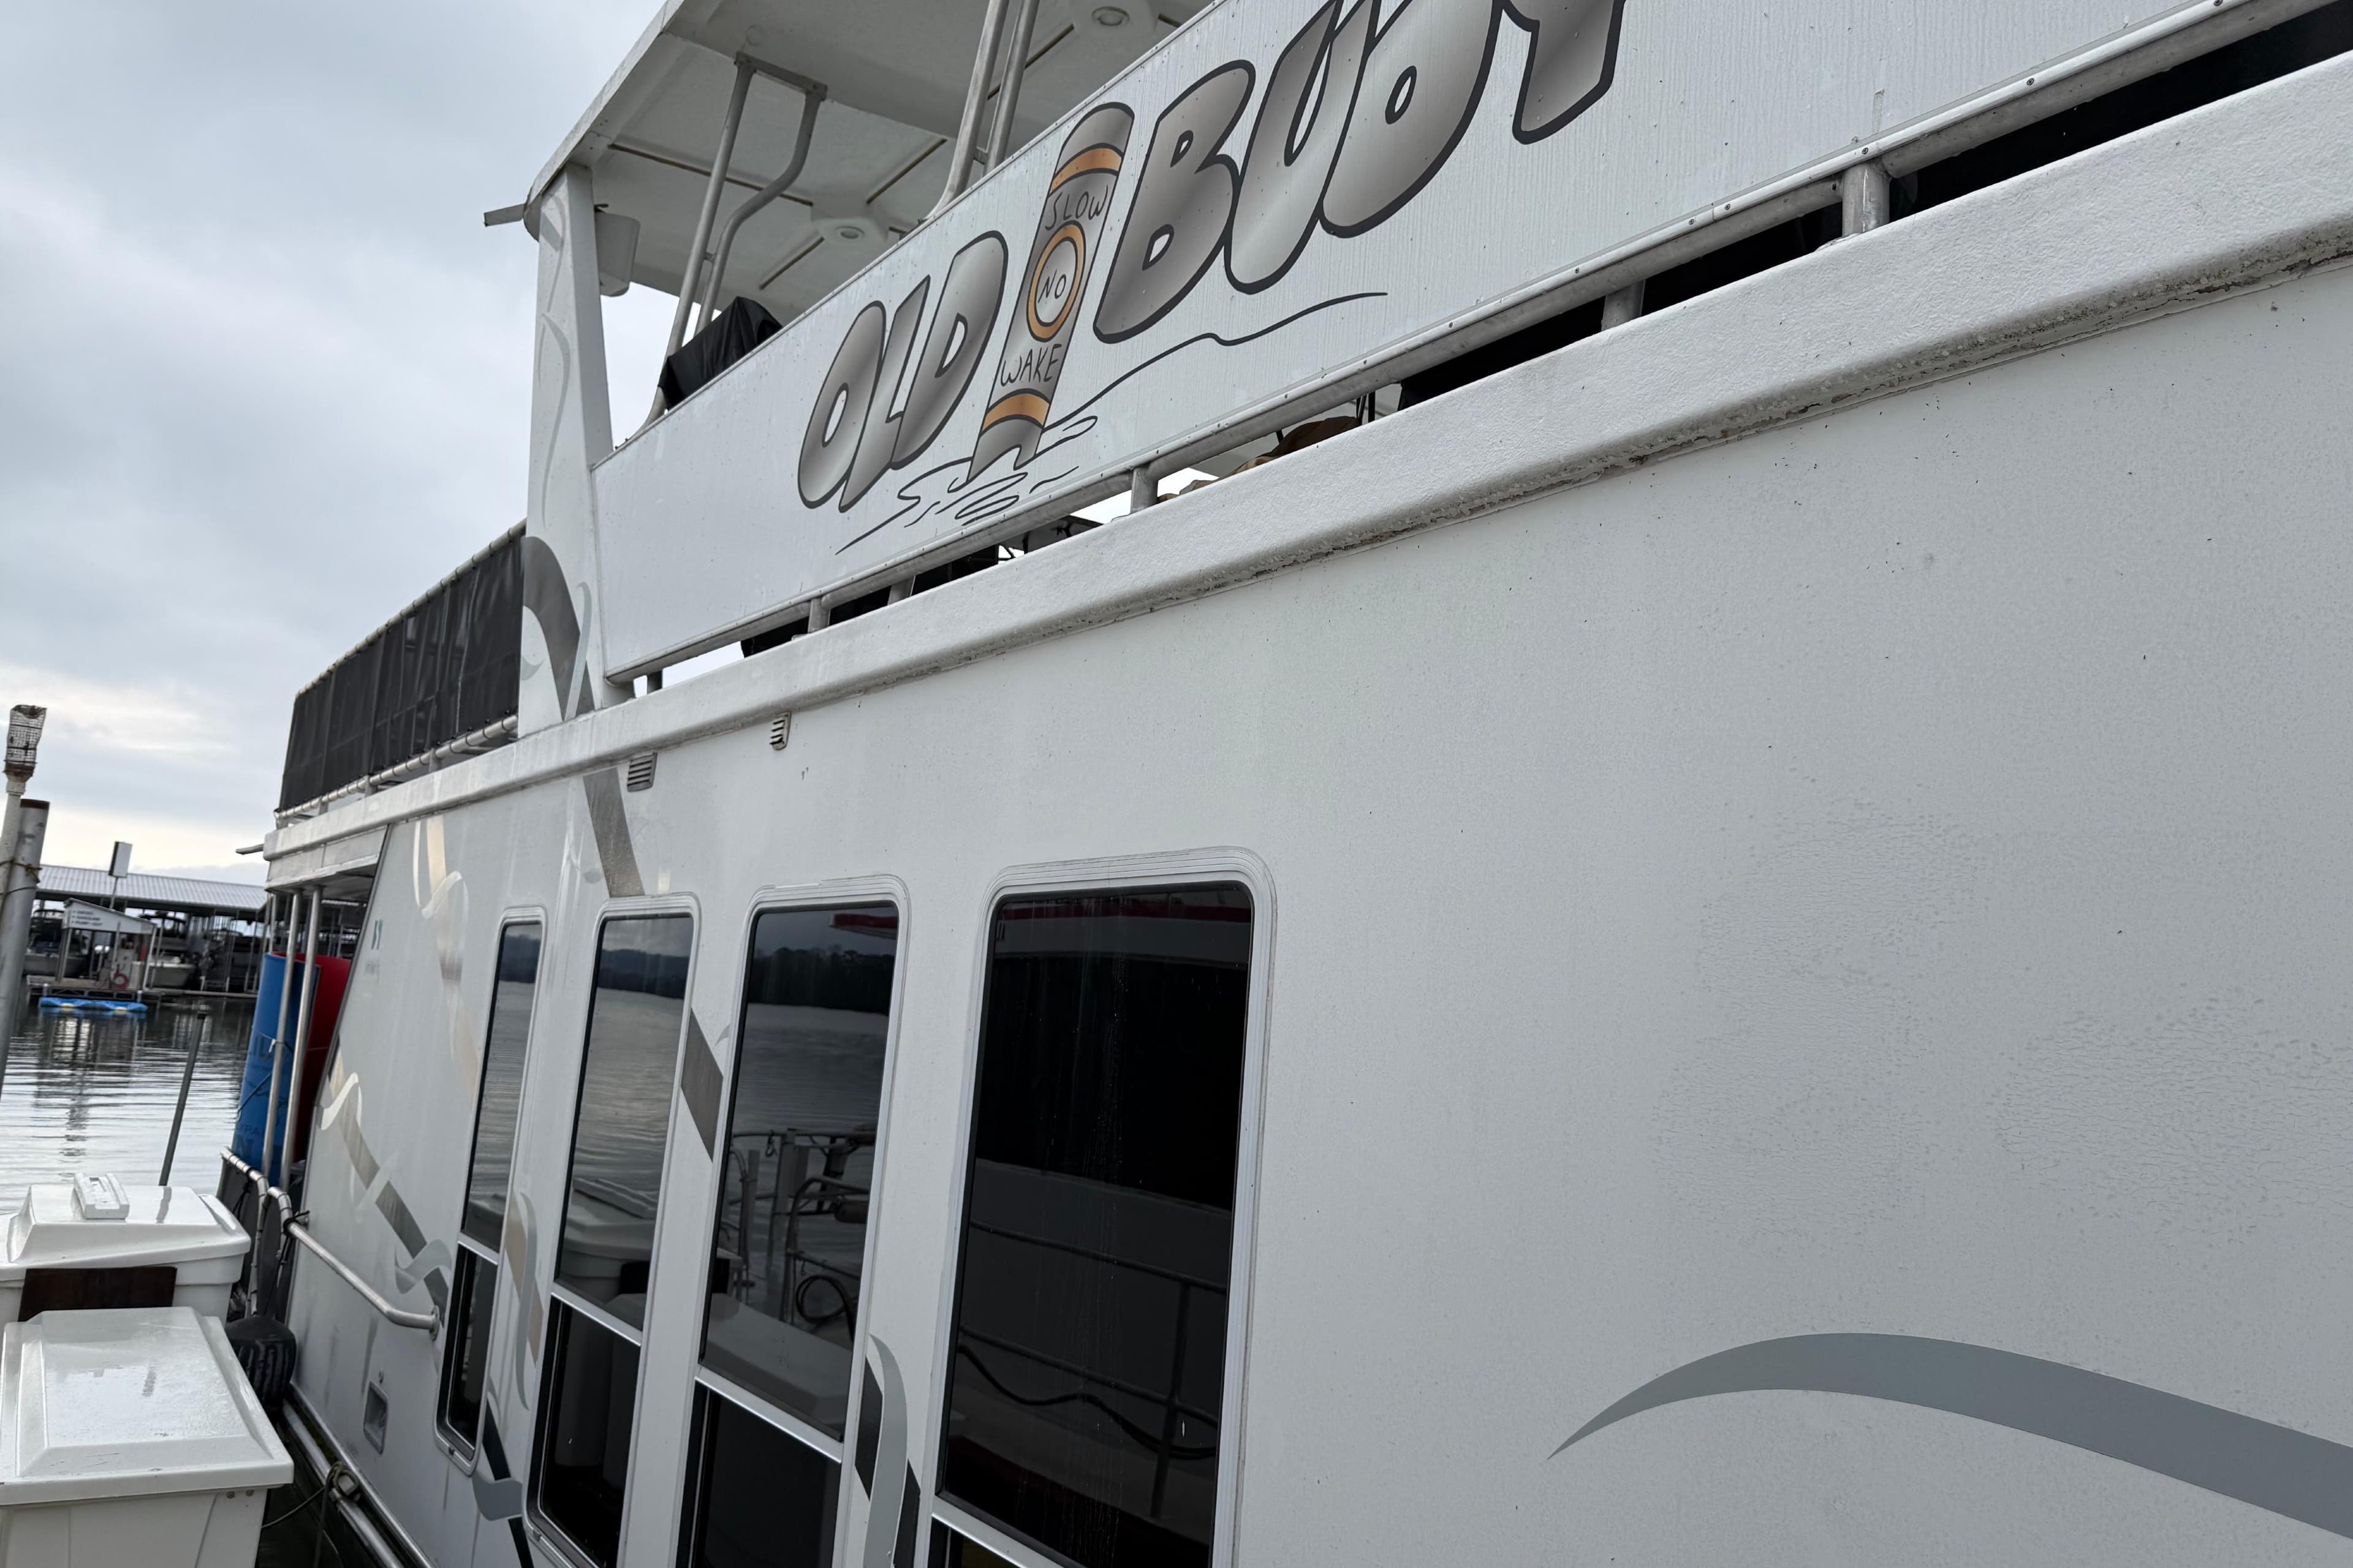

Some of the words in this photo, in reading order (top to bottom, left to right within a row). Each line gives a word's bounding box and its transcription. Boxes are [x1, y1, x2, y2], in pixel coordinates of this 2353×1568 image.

[1044, 184, 1108, 231] SLOW
[1037, 269, 1067, 303] NO
[797, 230, 1009, 513] OLD
[1000, 343, 1062, 387] WAKE
